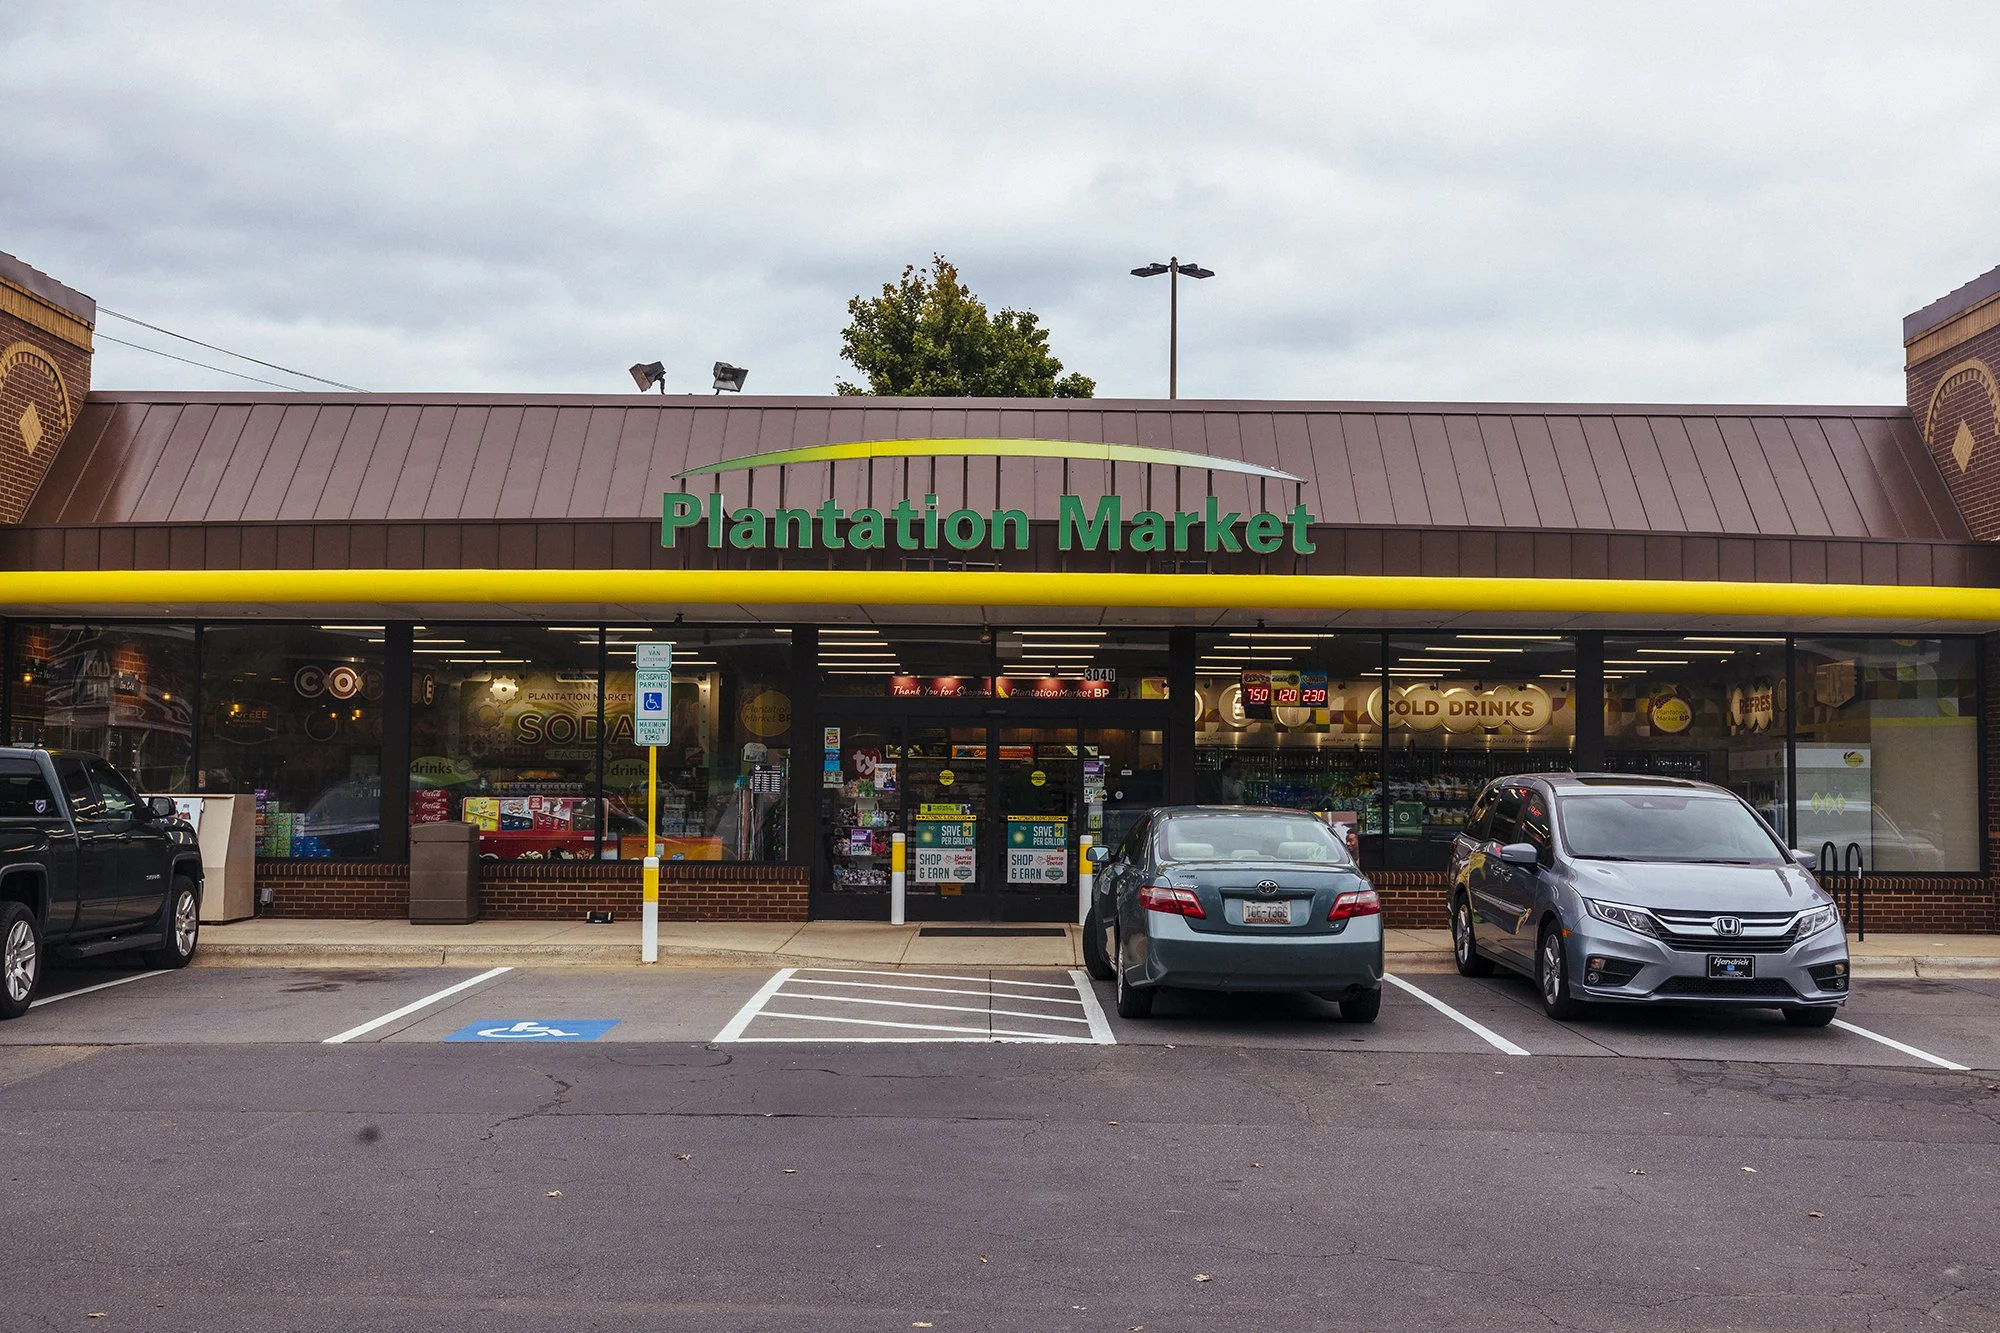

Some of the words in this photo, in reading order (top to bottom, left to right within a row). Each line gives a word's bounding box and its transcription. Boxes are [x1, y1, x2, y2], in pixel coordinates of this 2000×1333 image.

[661, 491, 1029, 550] Plantation
[1058, 494, 1317, 554] Market
[1085, 669, 1115, 682] 3040
[528, 693, 590, 701] PLANTATION
[893, 686, 920, 696] Thank
[924, 686, 938, 696] You
[940, 686, 953, 697] for
[1010, 687, 1058, 697] Plantation
[1059, 689, 1092, 697] Market
[1094, 688, 1110, 697] BP
[1247, 688, 1269, 701] 750
[1278, 689, 1297, 702] 120
[1302, 689, 1326, 702] 230
[1449, 700, 1535, 717] DRINKS
[517, 713, 635, 745] SODA
[553, 751, 597, 759] FACTOR
[411, 761, 452, 774] drinks
[852, 749, 877, 776] ty
[941, 825, 961, 836] SAVE
[963, 825, 971, 836] $1
[1033, 825, 1053, 837] SAVE
[1055, 826, 1063, 836] $1
[941, 837, 952, 845] PER
[1033, 837, 1043, 845] PER
[920, 854, 942, 865] SHOP
[1011, 854, 1033, 866] SHOP
[920, 868, 925, 878] &
[928, 868, 950, 879] EARN
[1011, 868, 1017, 879] &
[1020, 868, 1042, 879] EARN
[1713, 957, 1750, 967] Hendrick
